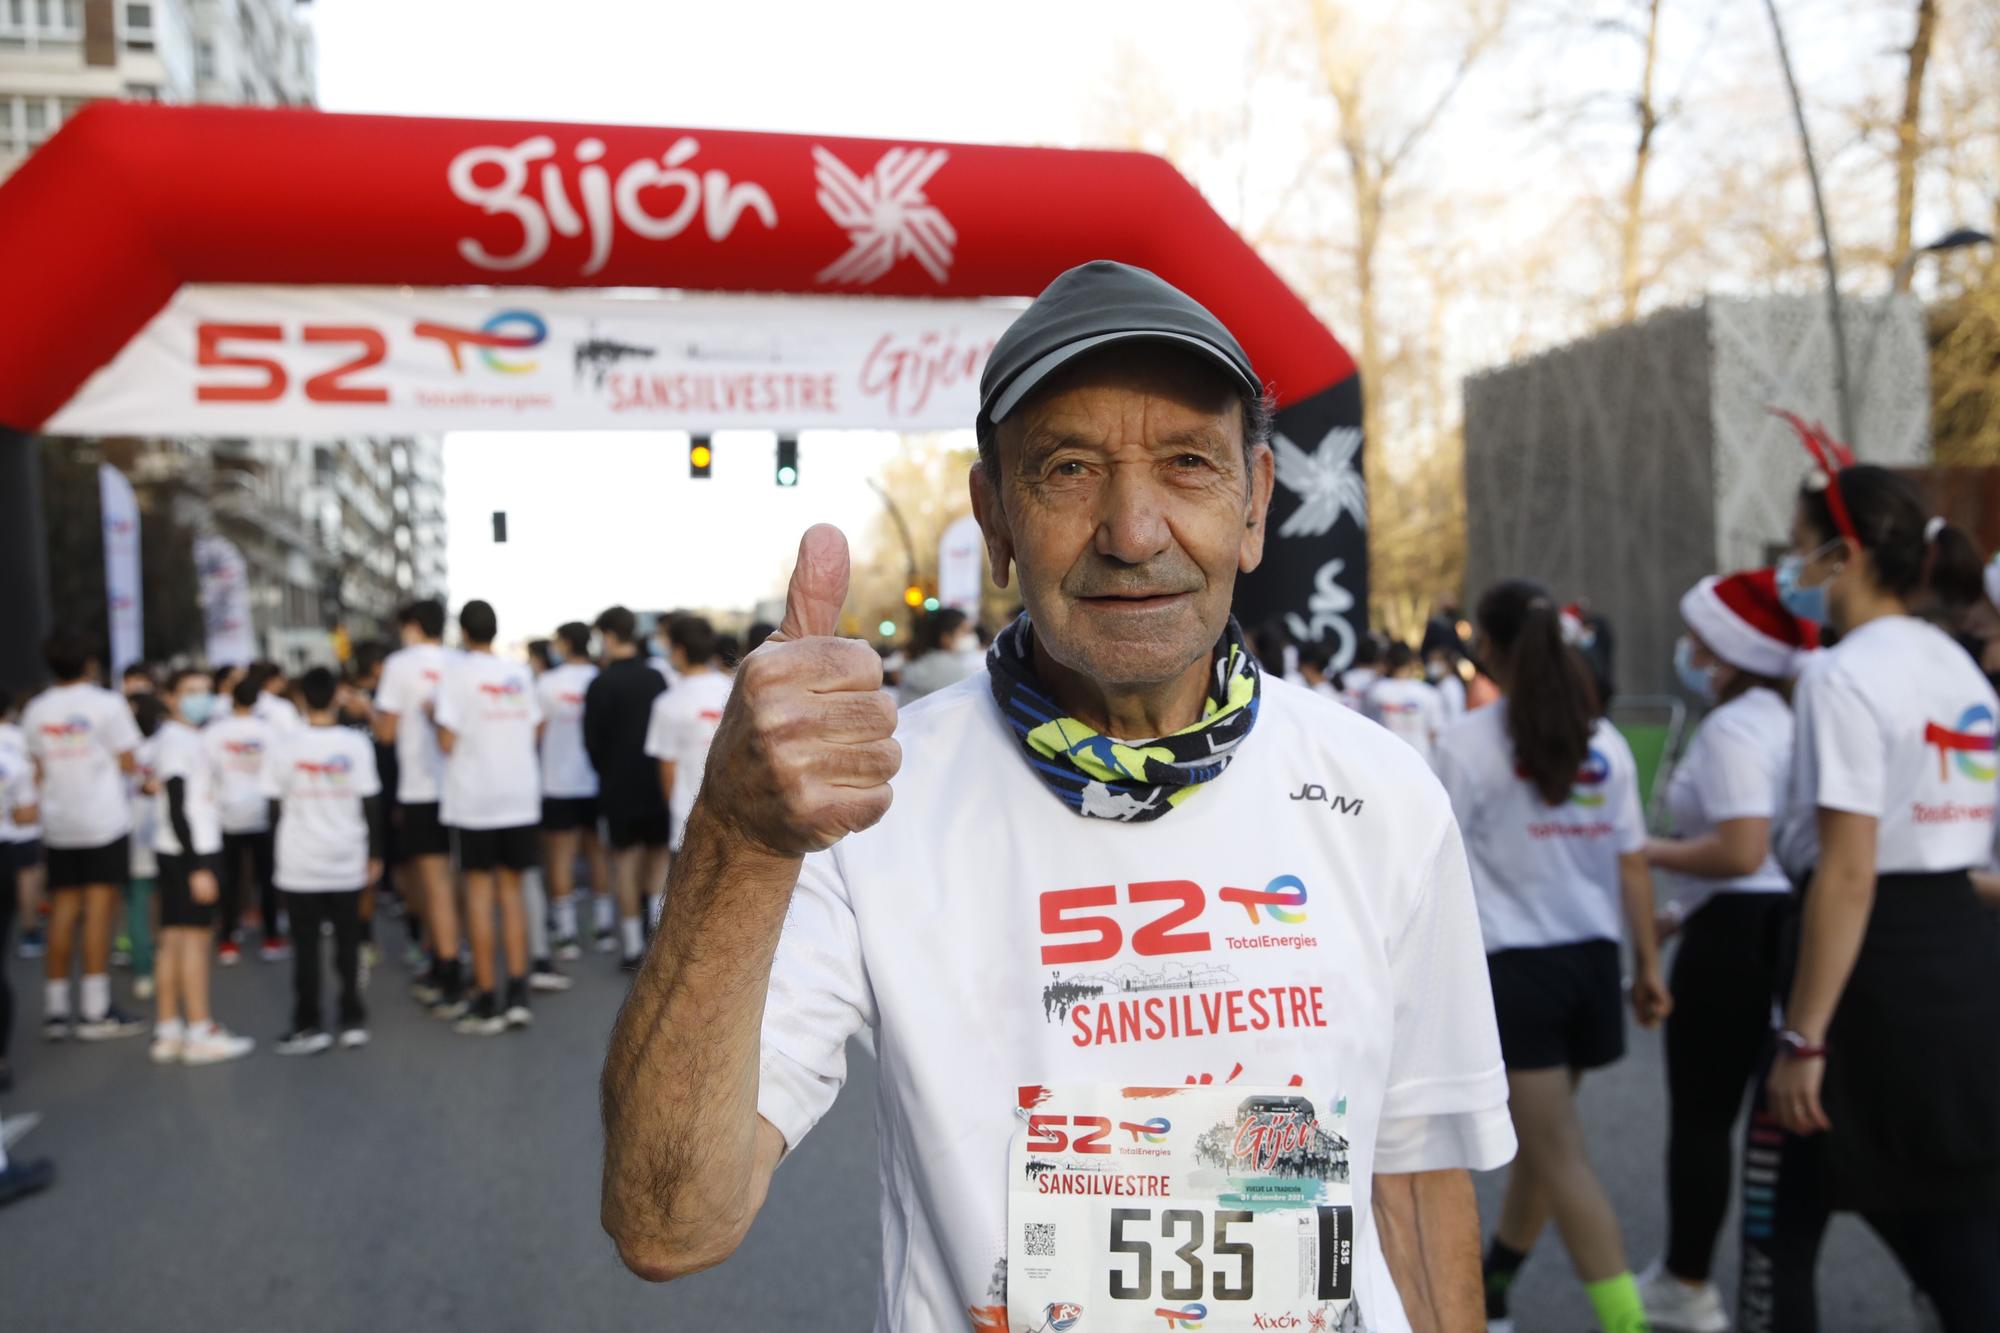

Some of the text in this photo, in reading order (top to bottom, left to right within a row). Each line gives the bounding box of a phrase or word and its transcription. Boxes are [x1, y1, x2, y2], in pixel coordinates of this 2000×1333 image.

[195, 322, 390, 405] 52
[608, 372, 838, 413] SANSILVESTRE
[1039, 879, 1211, 965] 52
[1225, 933, 1318, 950] TotalEnergies
[1071, 986, 1328, 1047] SANSILVESTRE
[1026, 1115, 1112, 1154] 52
[1119, 1146, 1172, 1157] TotalEnergies
[1039, 1174, 1170, 1197] SANSILVESTRE
[1109, 1208, 1254, 1300] 535
[1340, 1239, 1350, 1265] 535
